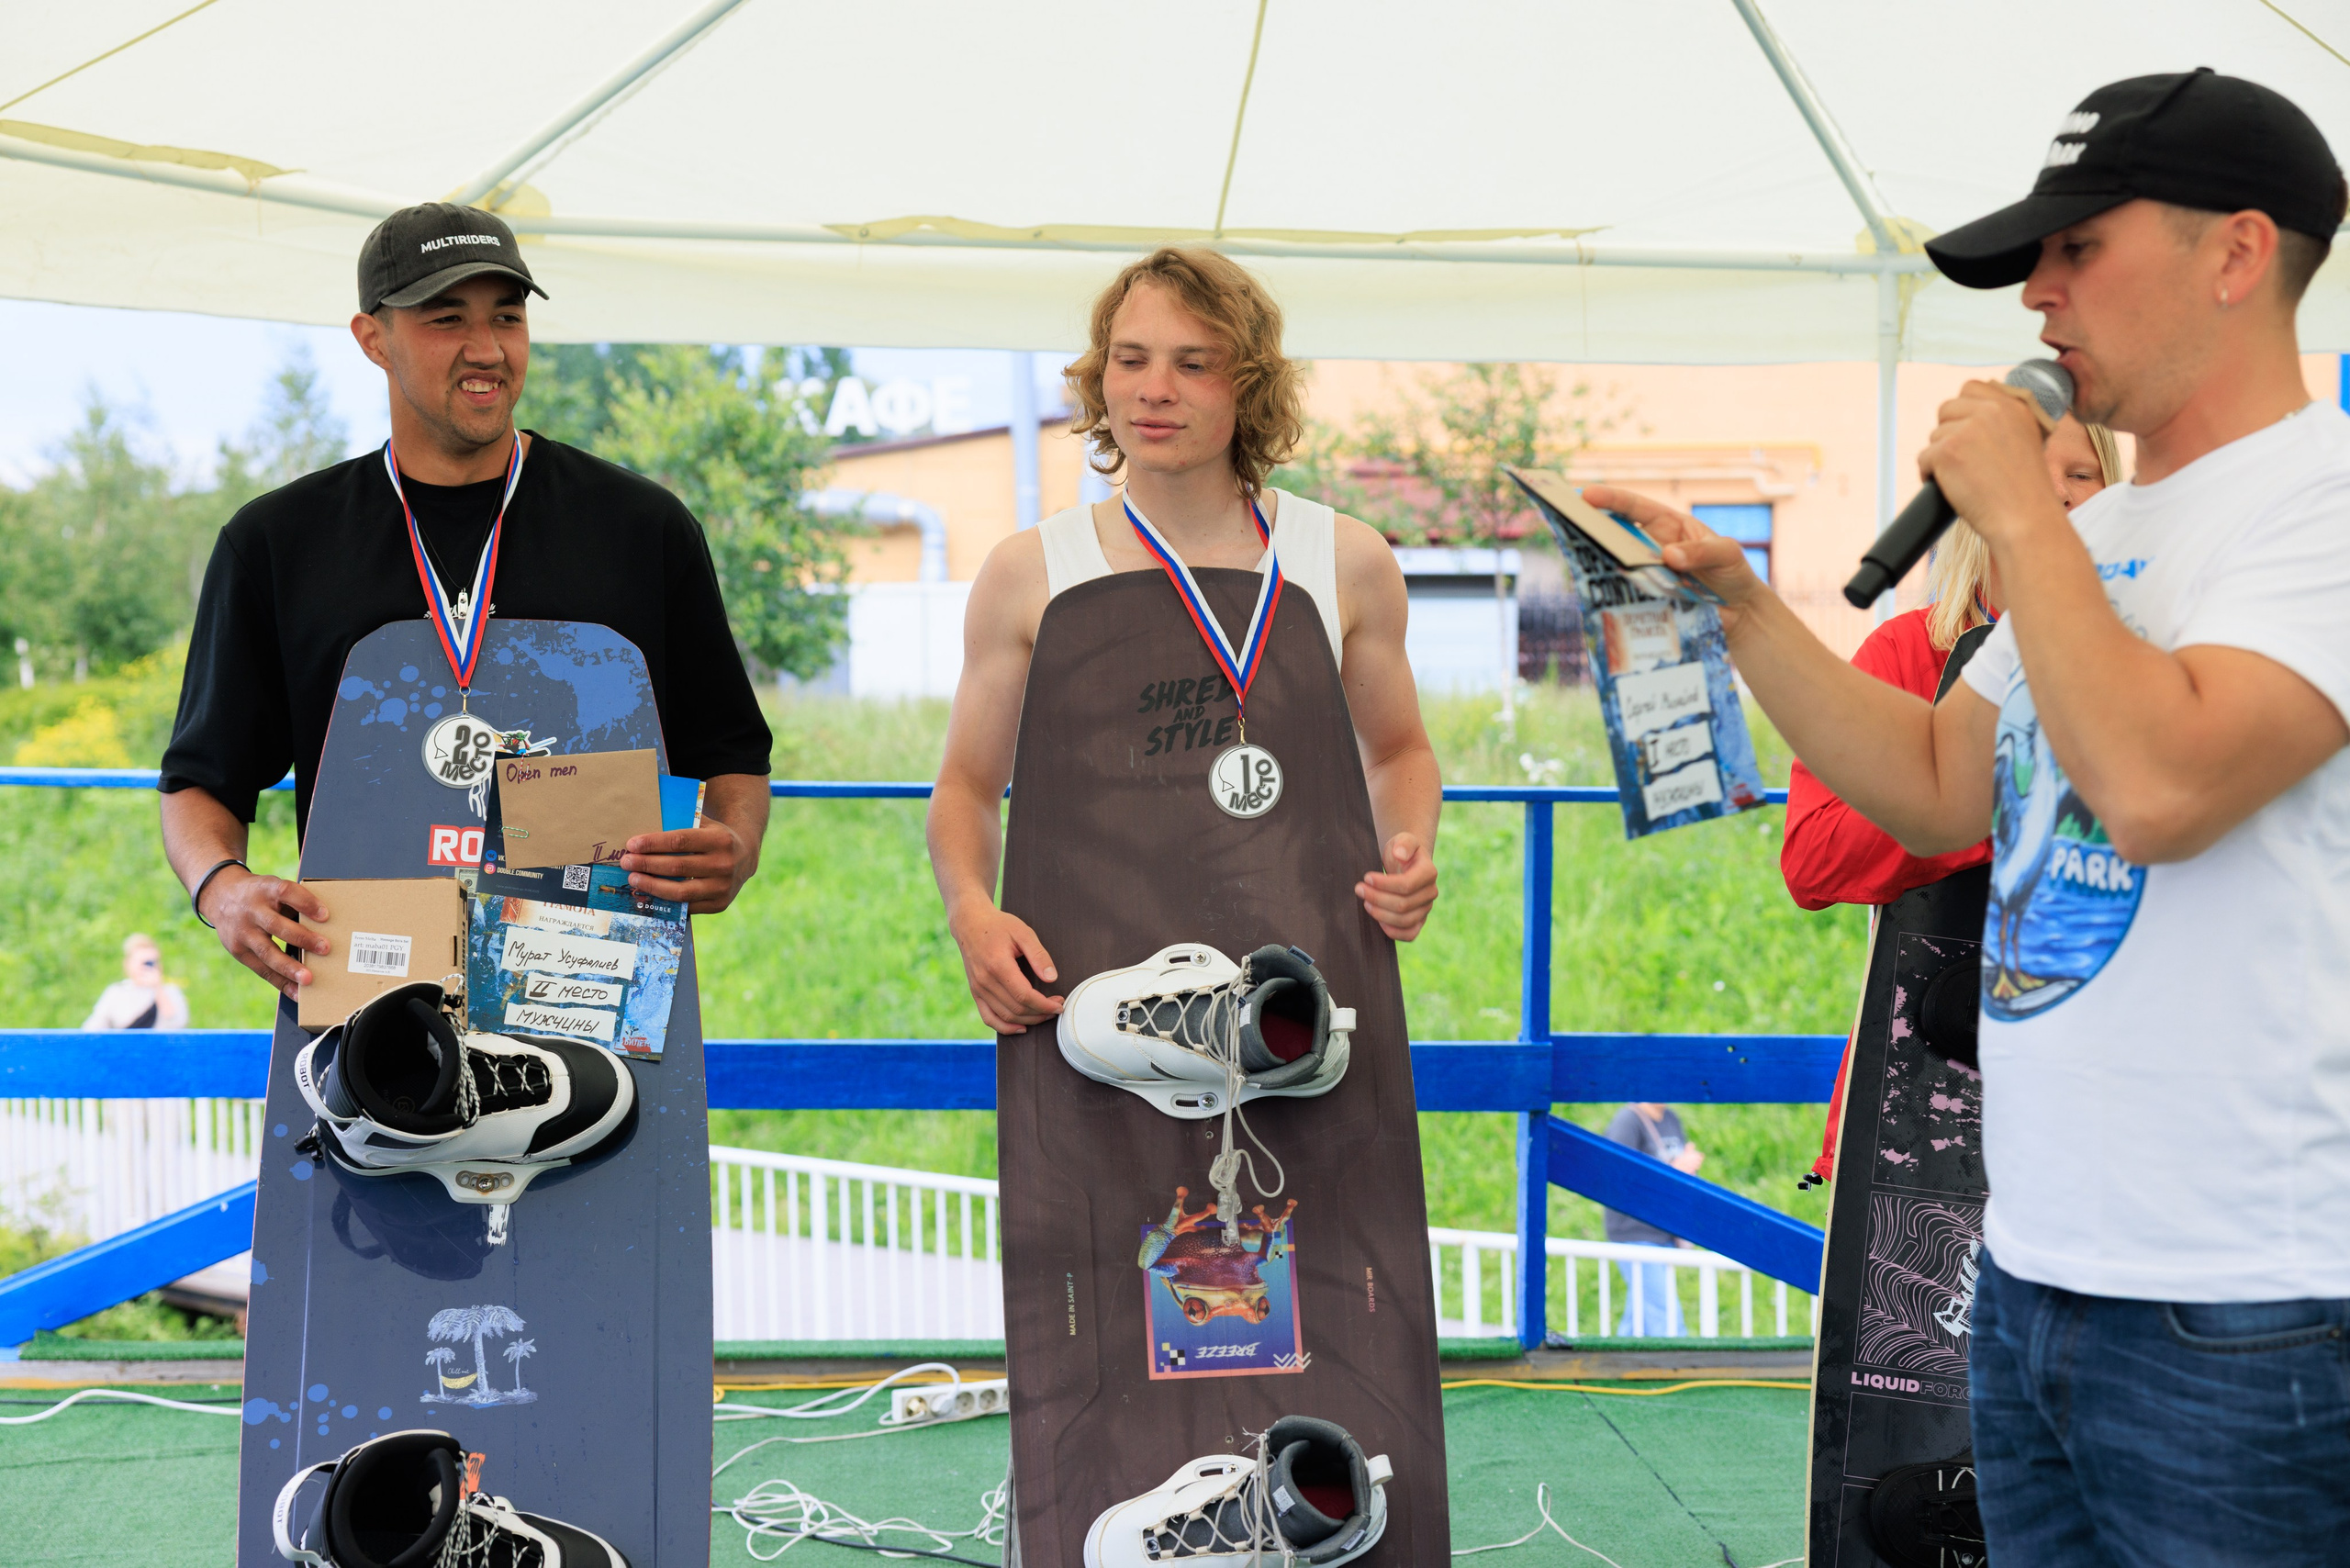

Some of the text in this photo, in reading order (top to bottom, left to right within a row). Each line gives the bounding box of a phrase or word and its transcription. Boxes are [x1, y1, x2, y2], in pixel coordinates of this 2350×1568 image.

[420, 234, 500, 253] MULTIRIDERS
[1173, 706, 1205, 722] AND
[453, 724, 471, 765] 2
[1145, 716, 1236, 756] STYLE
[507, 763, 577, 784] Open men
[2050, 846, 2134, 892] PARK
[644, 904, 671, 913] DOUBLE
[539, 916, 594, 931] НАГРАЖДАЕТСЯ
[508, 941, 552, 967] Мурат
[299, 1052, 310, 1087] ROBOT
[1367, 1282, 1376, 1313] BOARDS
[1069, 1305, 1076, 1313] IN
[1069, 1314, 1077, 1336] MADE
[1194, 1341, 1262, 1359] BREEZE
